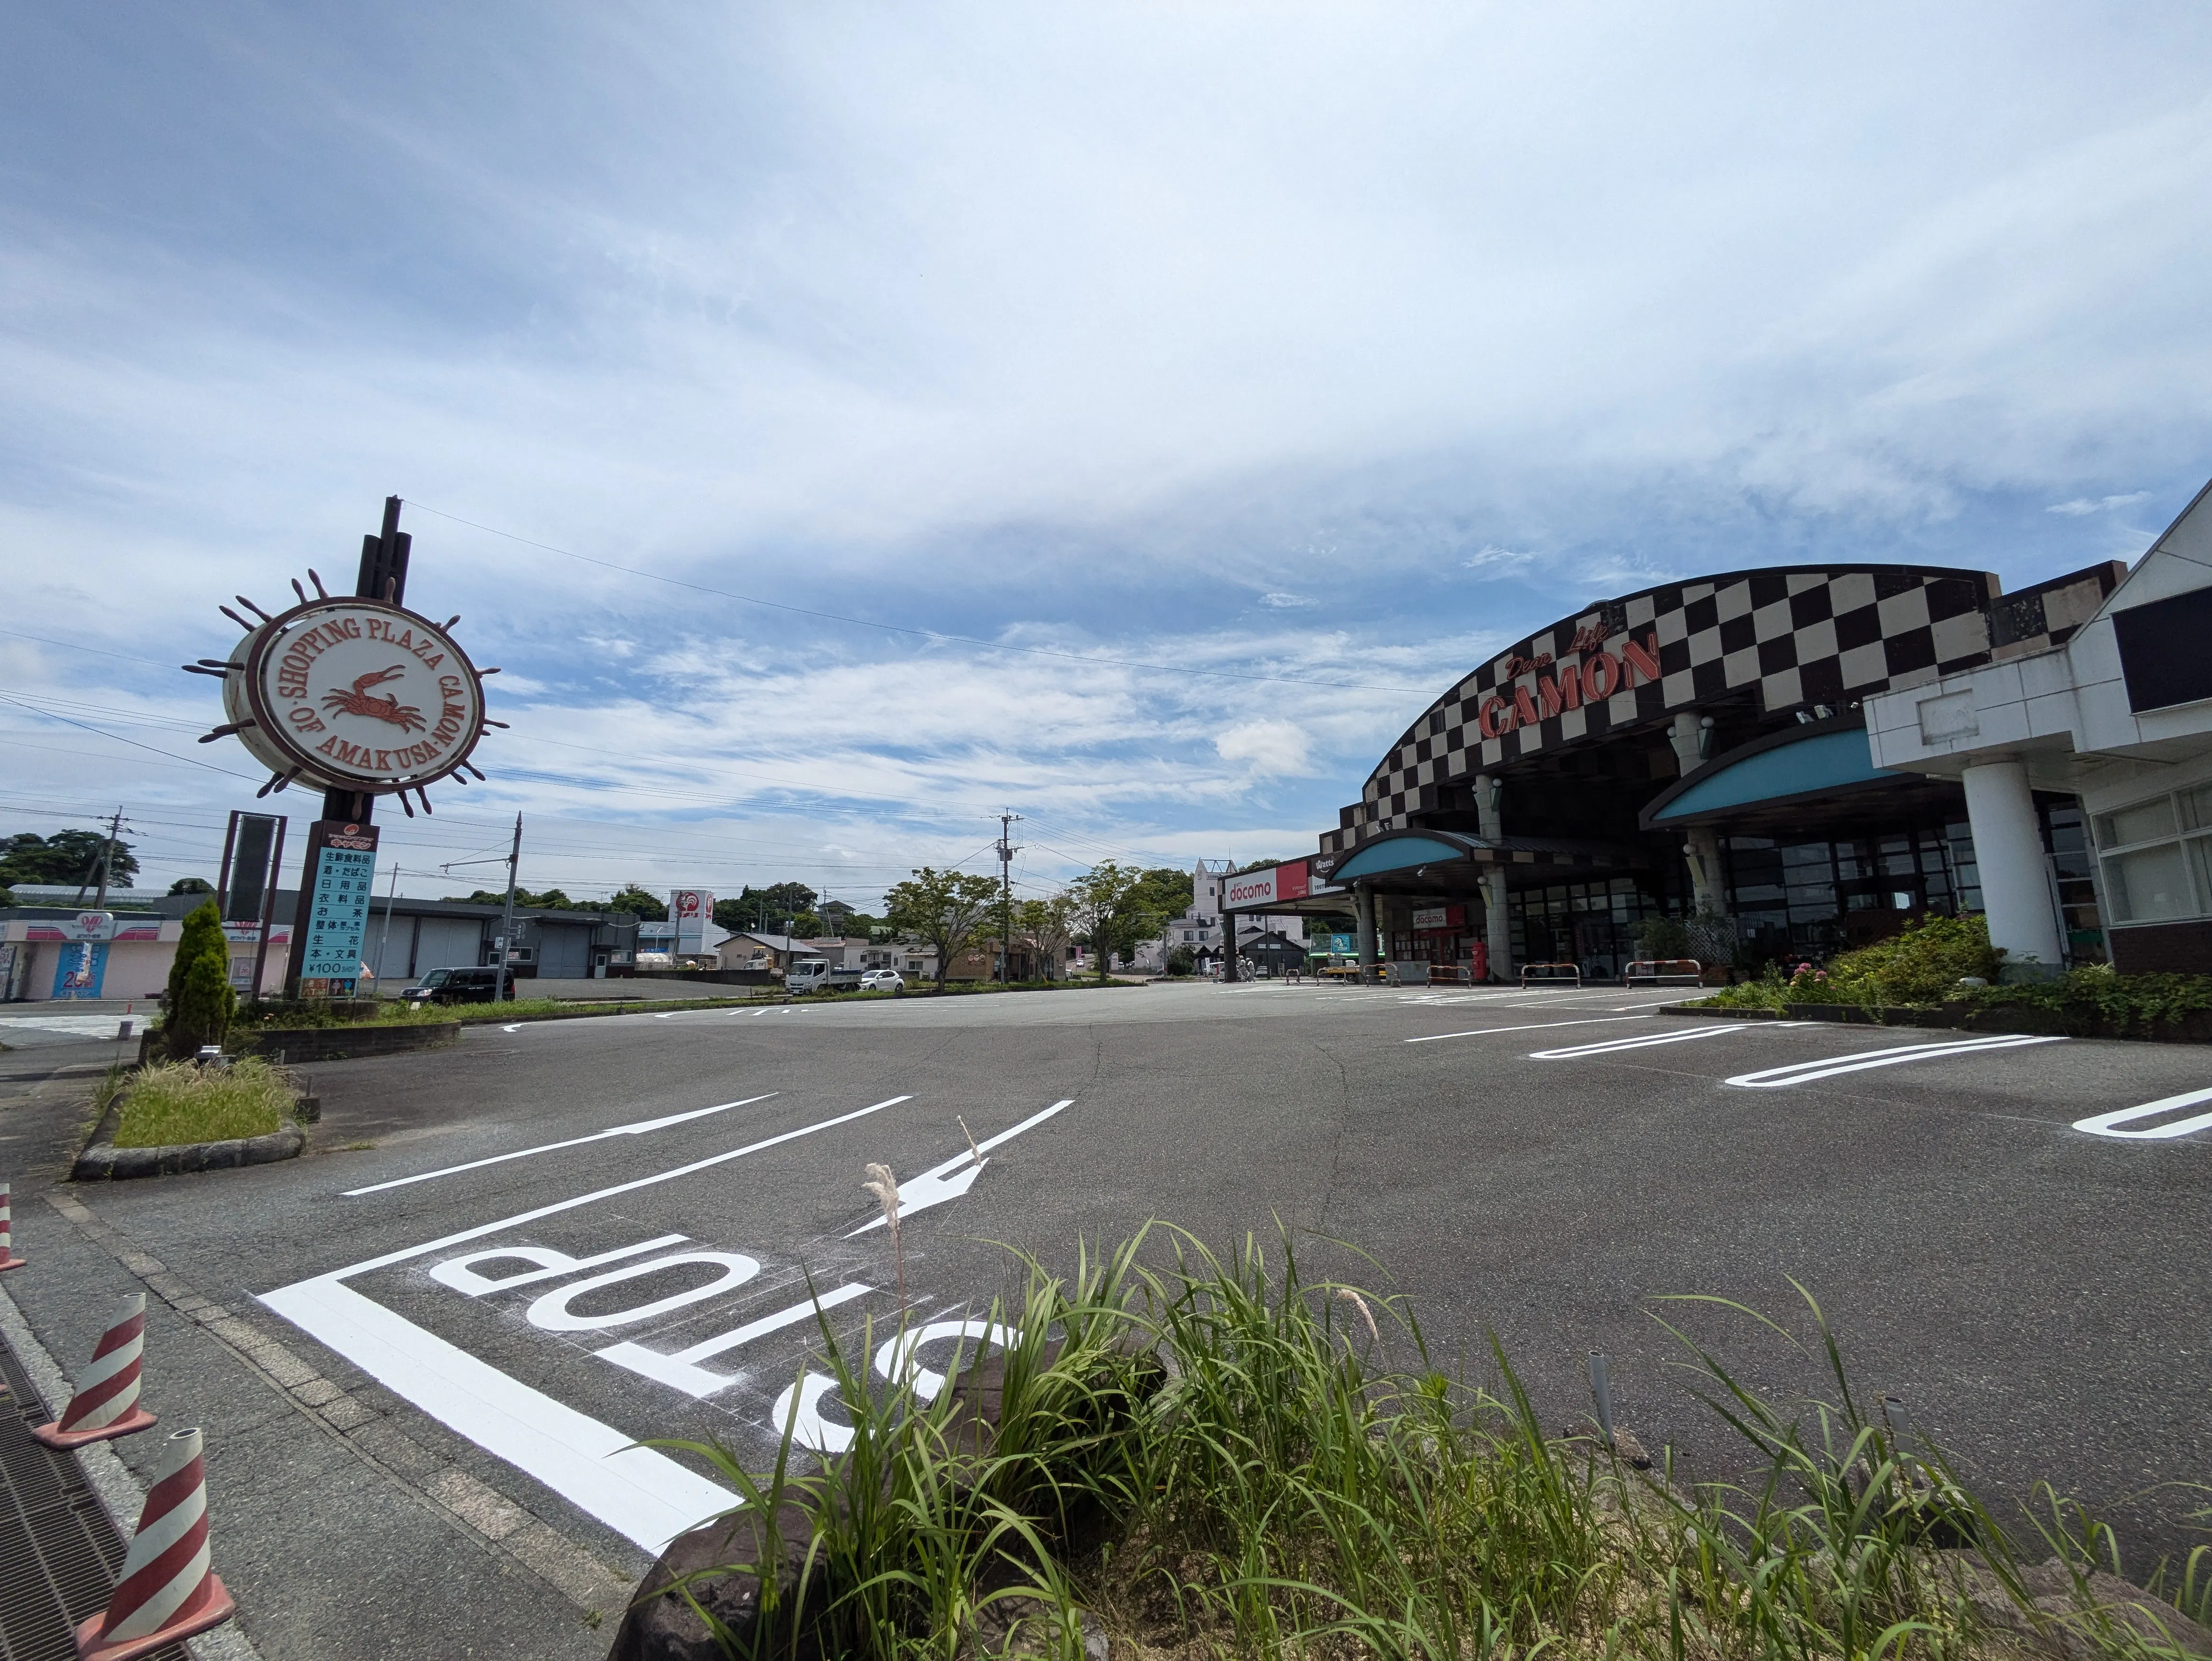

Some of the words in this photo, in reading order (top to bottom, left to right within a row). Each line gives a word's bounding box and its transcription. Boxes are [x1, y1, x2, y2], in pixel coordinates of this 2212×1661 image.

[1505, 652, 1552, 681] Dear
[1567, 621, 1610, 655] Life
[278, 617, 362, 699] SHOPPING
[366, 618, 445, 671] PLAZA
[431, 675, 465, 748] CAMON
[1478, 631, 1661, 740] CAMON
[288, 707, 326, 734] OF
[316, 735, 442, 771] AMAKUSA
[331, 839, 371, 850] キャモン
[325, 852, 370, 864] 生鮮食料品
[1316, 859, 1334, 870] Watts
[323, 865, 367, 877] 酒・たばこ
[322, 879, 366, 891] 日用品
[1230, 882, 1271, 902] docomo
[319, 893, 365, 905] 衣料品
[317, 907, 363, 918] お茶
[1416, 915, 1443, 924] docomo
[313, 934, 359, 945] 生花
[309, 963, 341, 973] ¥100
[429, 1233, 1024, 1453] STOP
